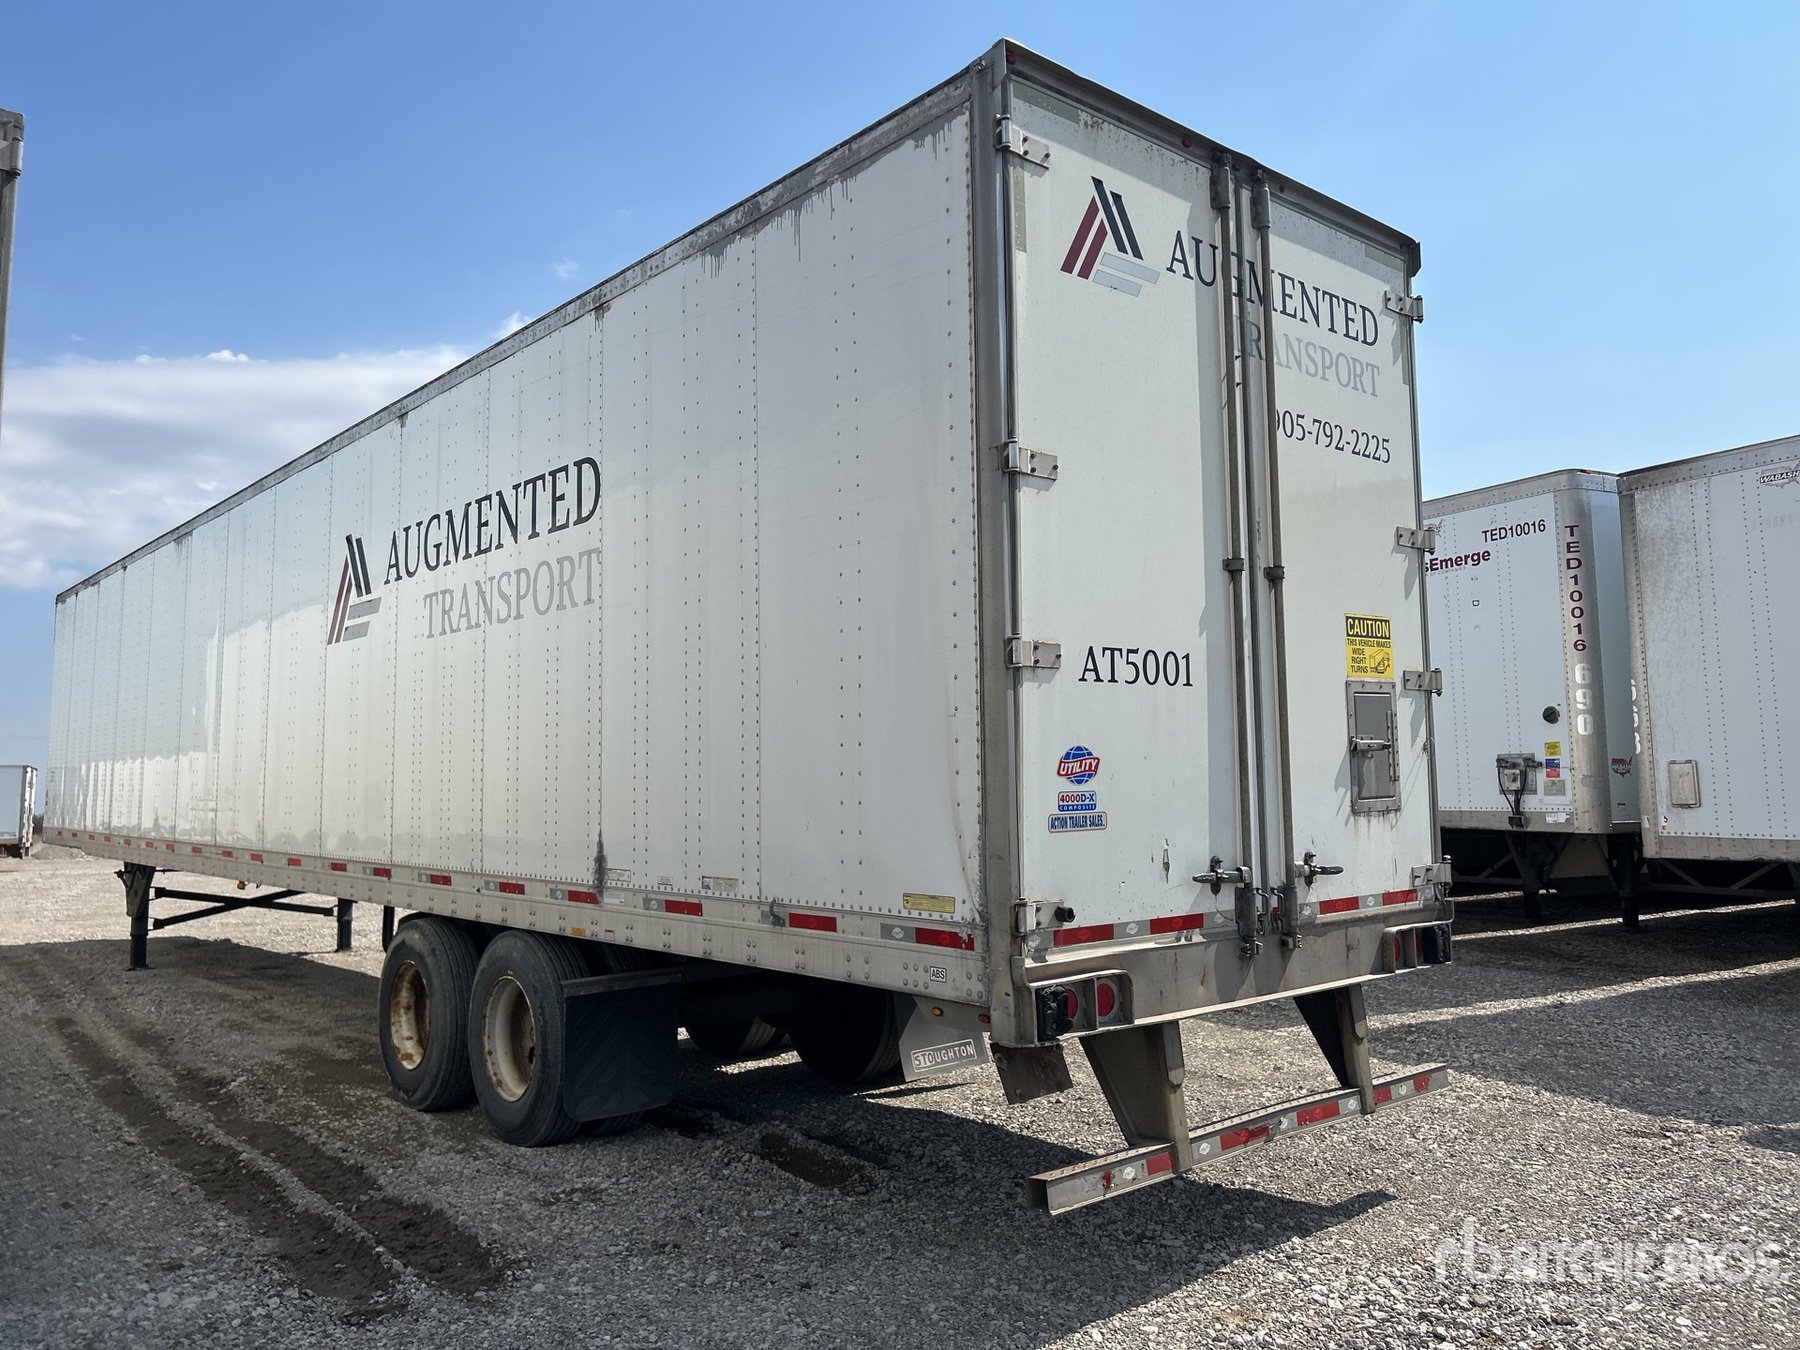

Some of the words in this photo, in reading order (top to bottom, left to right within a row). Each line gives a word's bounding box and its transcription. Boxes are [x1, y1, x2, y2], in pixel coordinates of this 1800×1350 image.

[1760, 470, 1800, 483] WABASH
[384, 456, 601, 585] AUGMENTED
[1481, 519, 1546, 543] TED10016
[423, 547, 601, 639] TRANSPORT
[1564, 524, 1587, 652] TED10016
[1347, 618, 1389, 637] CAUTION
[1347, 638, 1357, 647] THIS
[1358, 639, 1375, 647] VEHICLE
[1376, 640, 1391, 648] MAKES
[1352, 648, 1365, 656] WIDE
[1078, 646, 1193, 687] AT5001
[1351, 665, 1368, 673] TURNS
[1060, 759, 1098, 774] UTILITY
[1060, 794, 1095, 803] 4000D-X
[1050, 817, 1068, 830] ACTION
[1069, 816, 1088, 829] TRAILER
[931, 969, 945, 980] ABS
[914, 1044, 974, 1067] STOUGHTON
